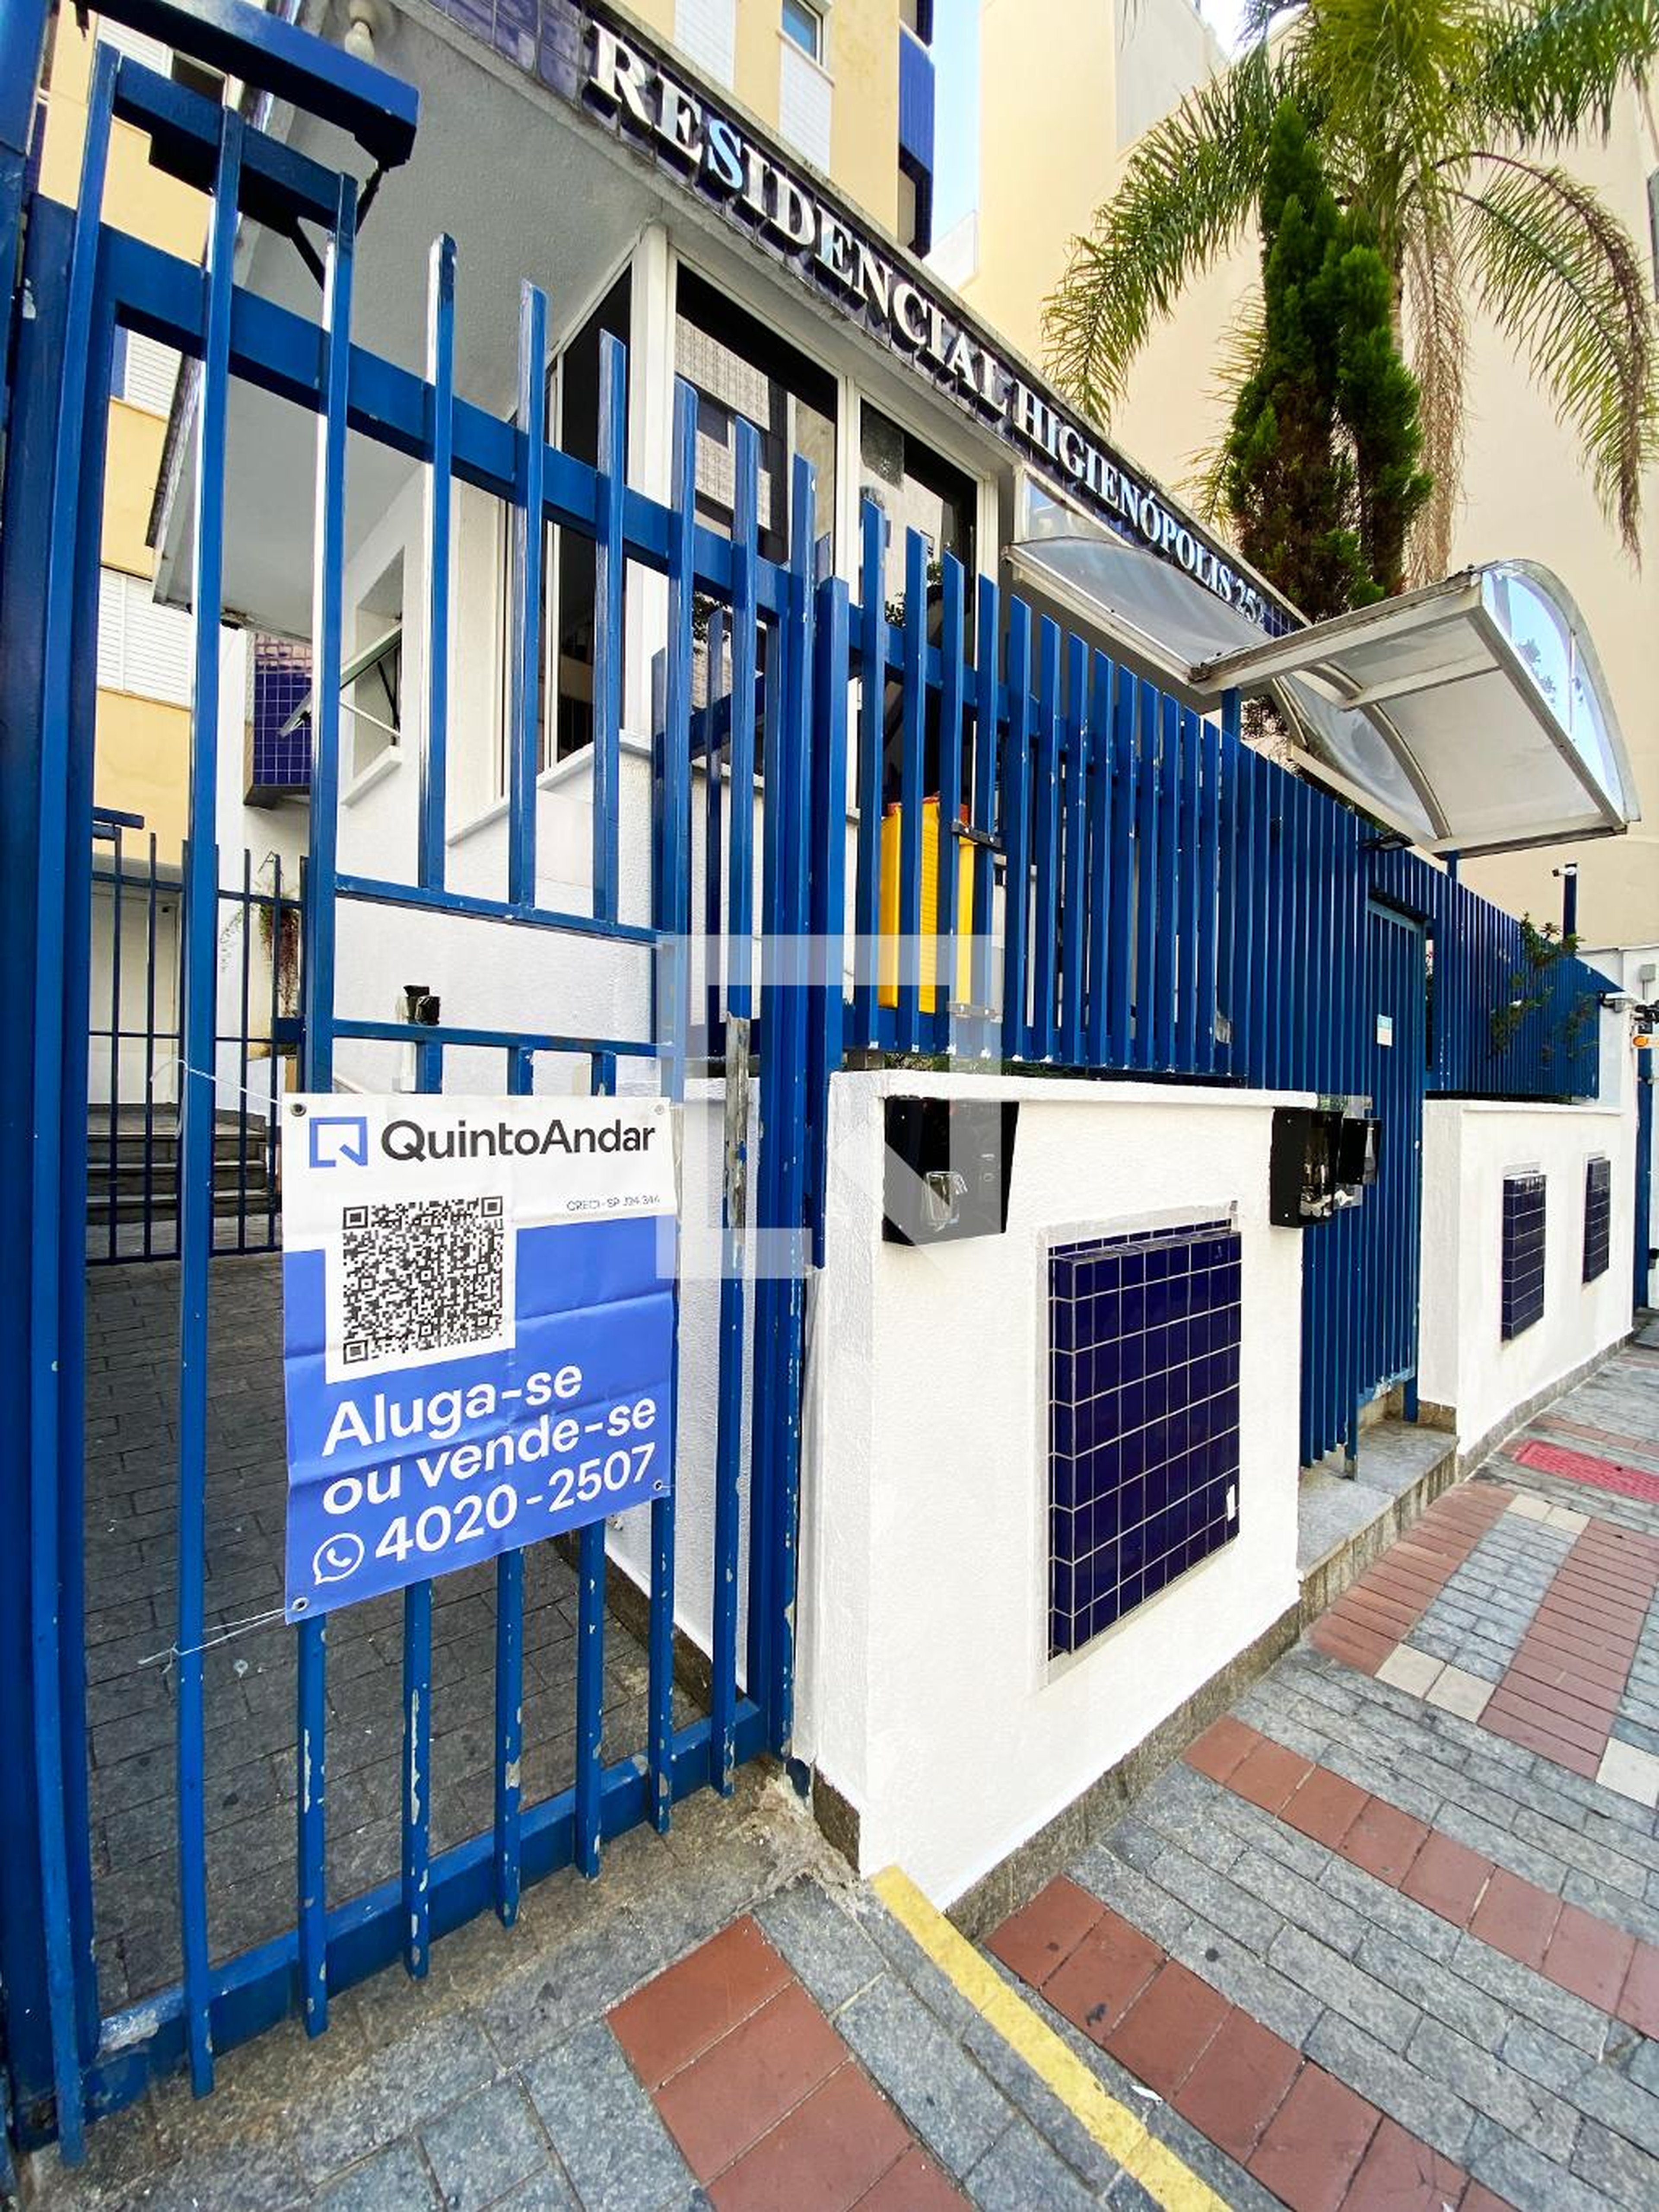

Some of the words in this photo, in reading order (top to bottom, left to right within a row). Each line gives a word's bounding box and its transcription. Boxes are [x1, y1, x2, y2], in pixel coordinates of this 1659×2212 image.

[590, 20, 1007, 416] RESIDENCIAL
[1015, 379, 1232, 602] HIGIENÓPOLIS
[381, 1119, 655, 1162] QuintoAndar
[321, 1363, 582, 1457] Aluga-se
[323, 1464, 400, 1515] ou
[416, 1397, 656, 1488] vende-se
[375, 1442, 656, 1561] 4020-2507
